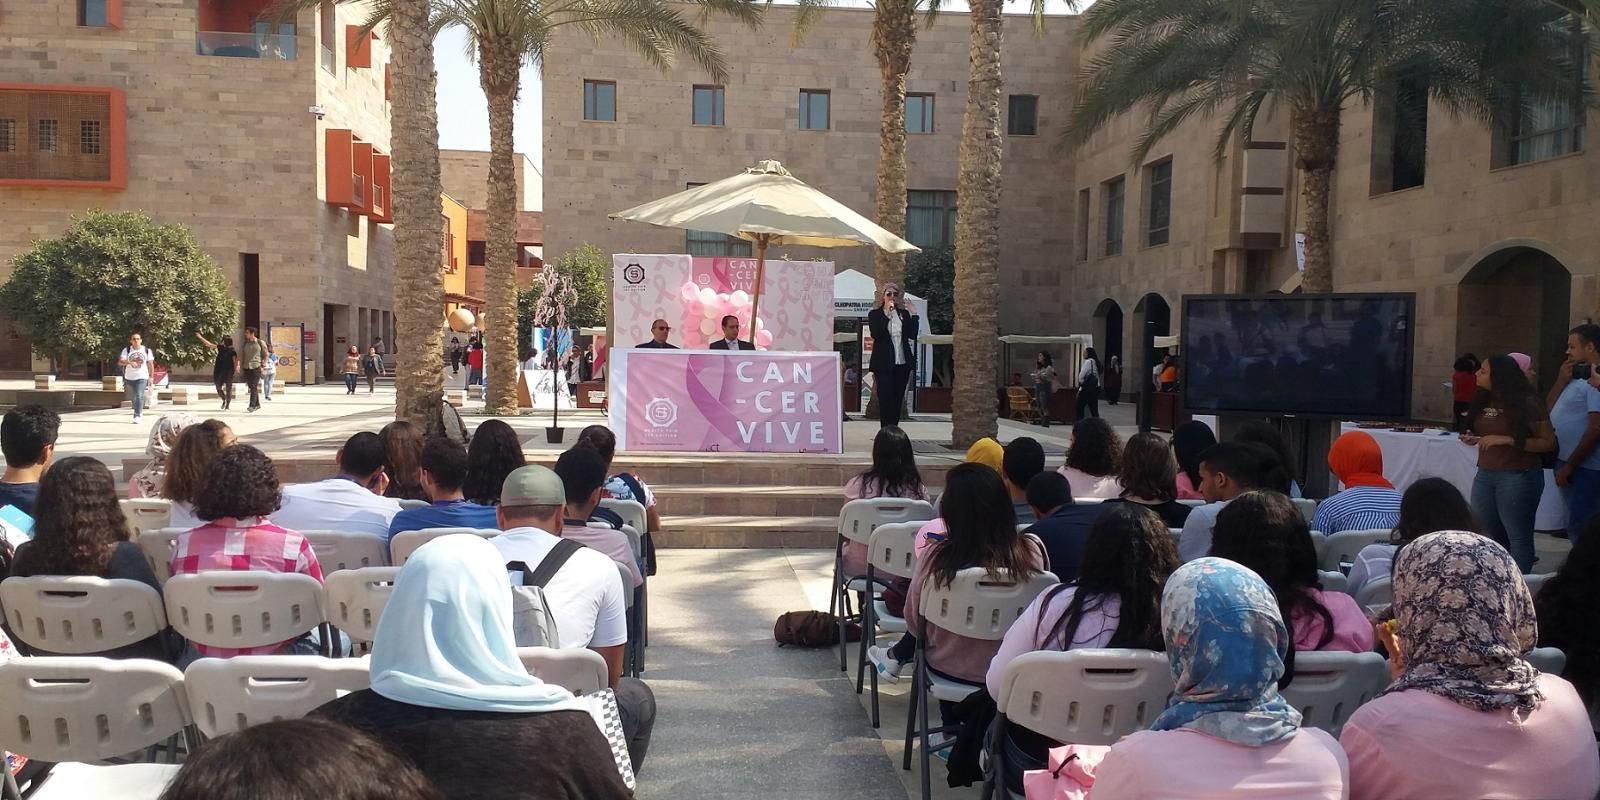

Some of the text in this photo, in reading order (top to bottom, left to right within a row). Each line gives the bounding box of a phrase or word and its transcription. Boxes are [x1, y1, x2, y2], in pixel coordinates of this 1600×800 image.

[730, 260, 757, 269] CAN
[730, 281, 753, 290] VIV
[736, 361, 812, 384] CAN
[736, 391, 819, 413] -CER
[736, 421, 824, 444] VIVE
